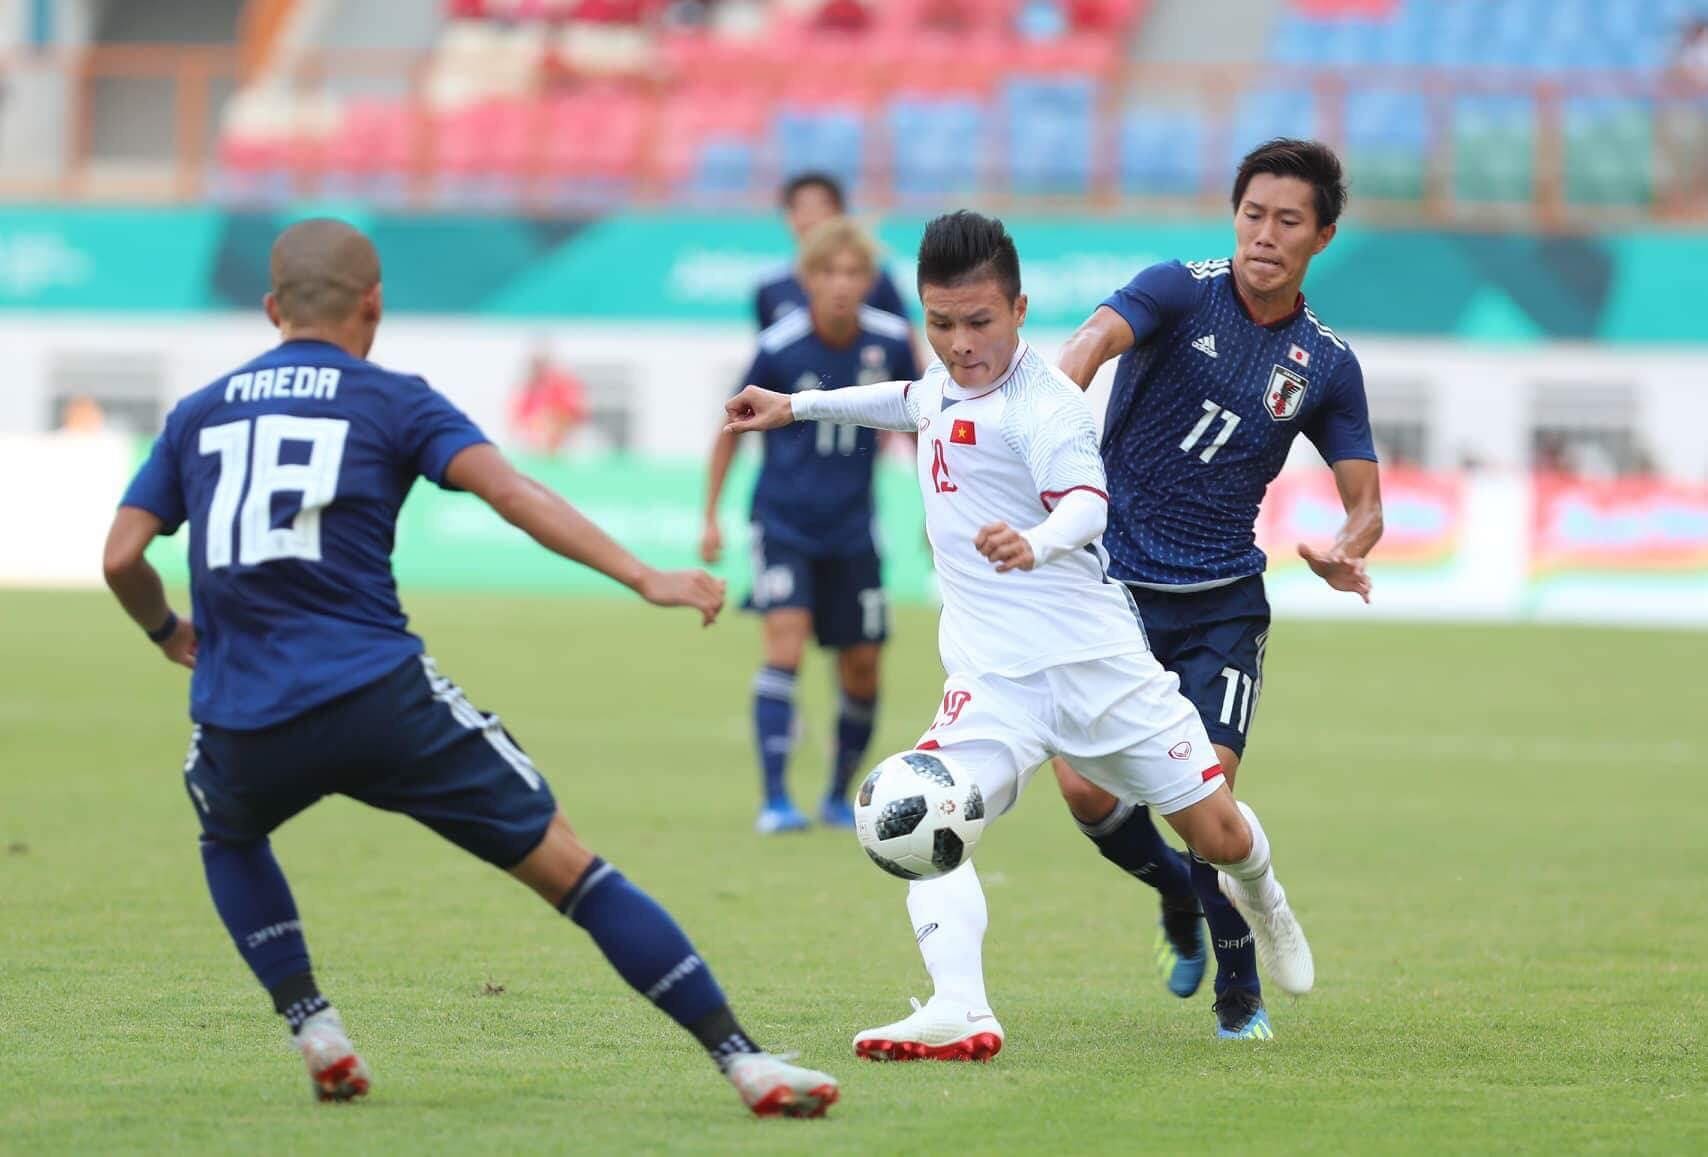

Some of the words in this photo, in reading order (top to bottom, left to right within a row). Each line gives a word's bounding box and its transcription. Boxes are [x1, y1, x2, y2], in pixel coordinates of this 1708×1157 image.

[224, 365, 342, 403] MAEDA
[1178, 399, 1242, 464] 11
[198, 413, 350, 570] 18
[1219, 666, 1253, 735] 11
